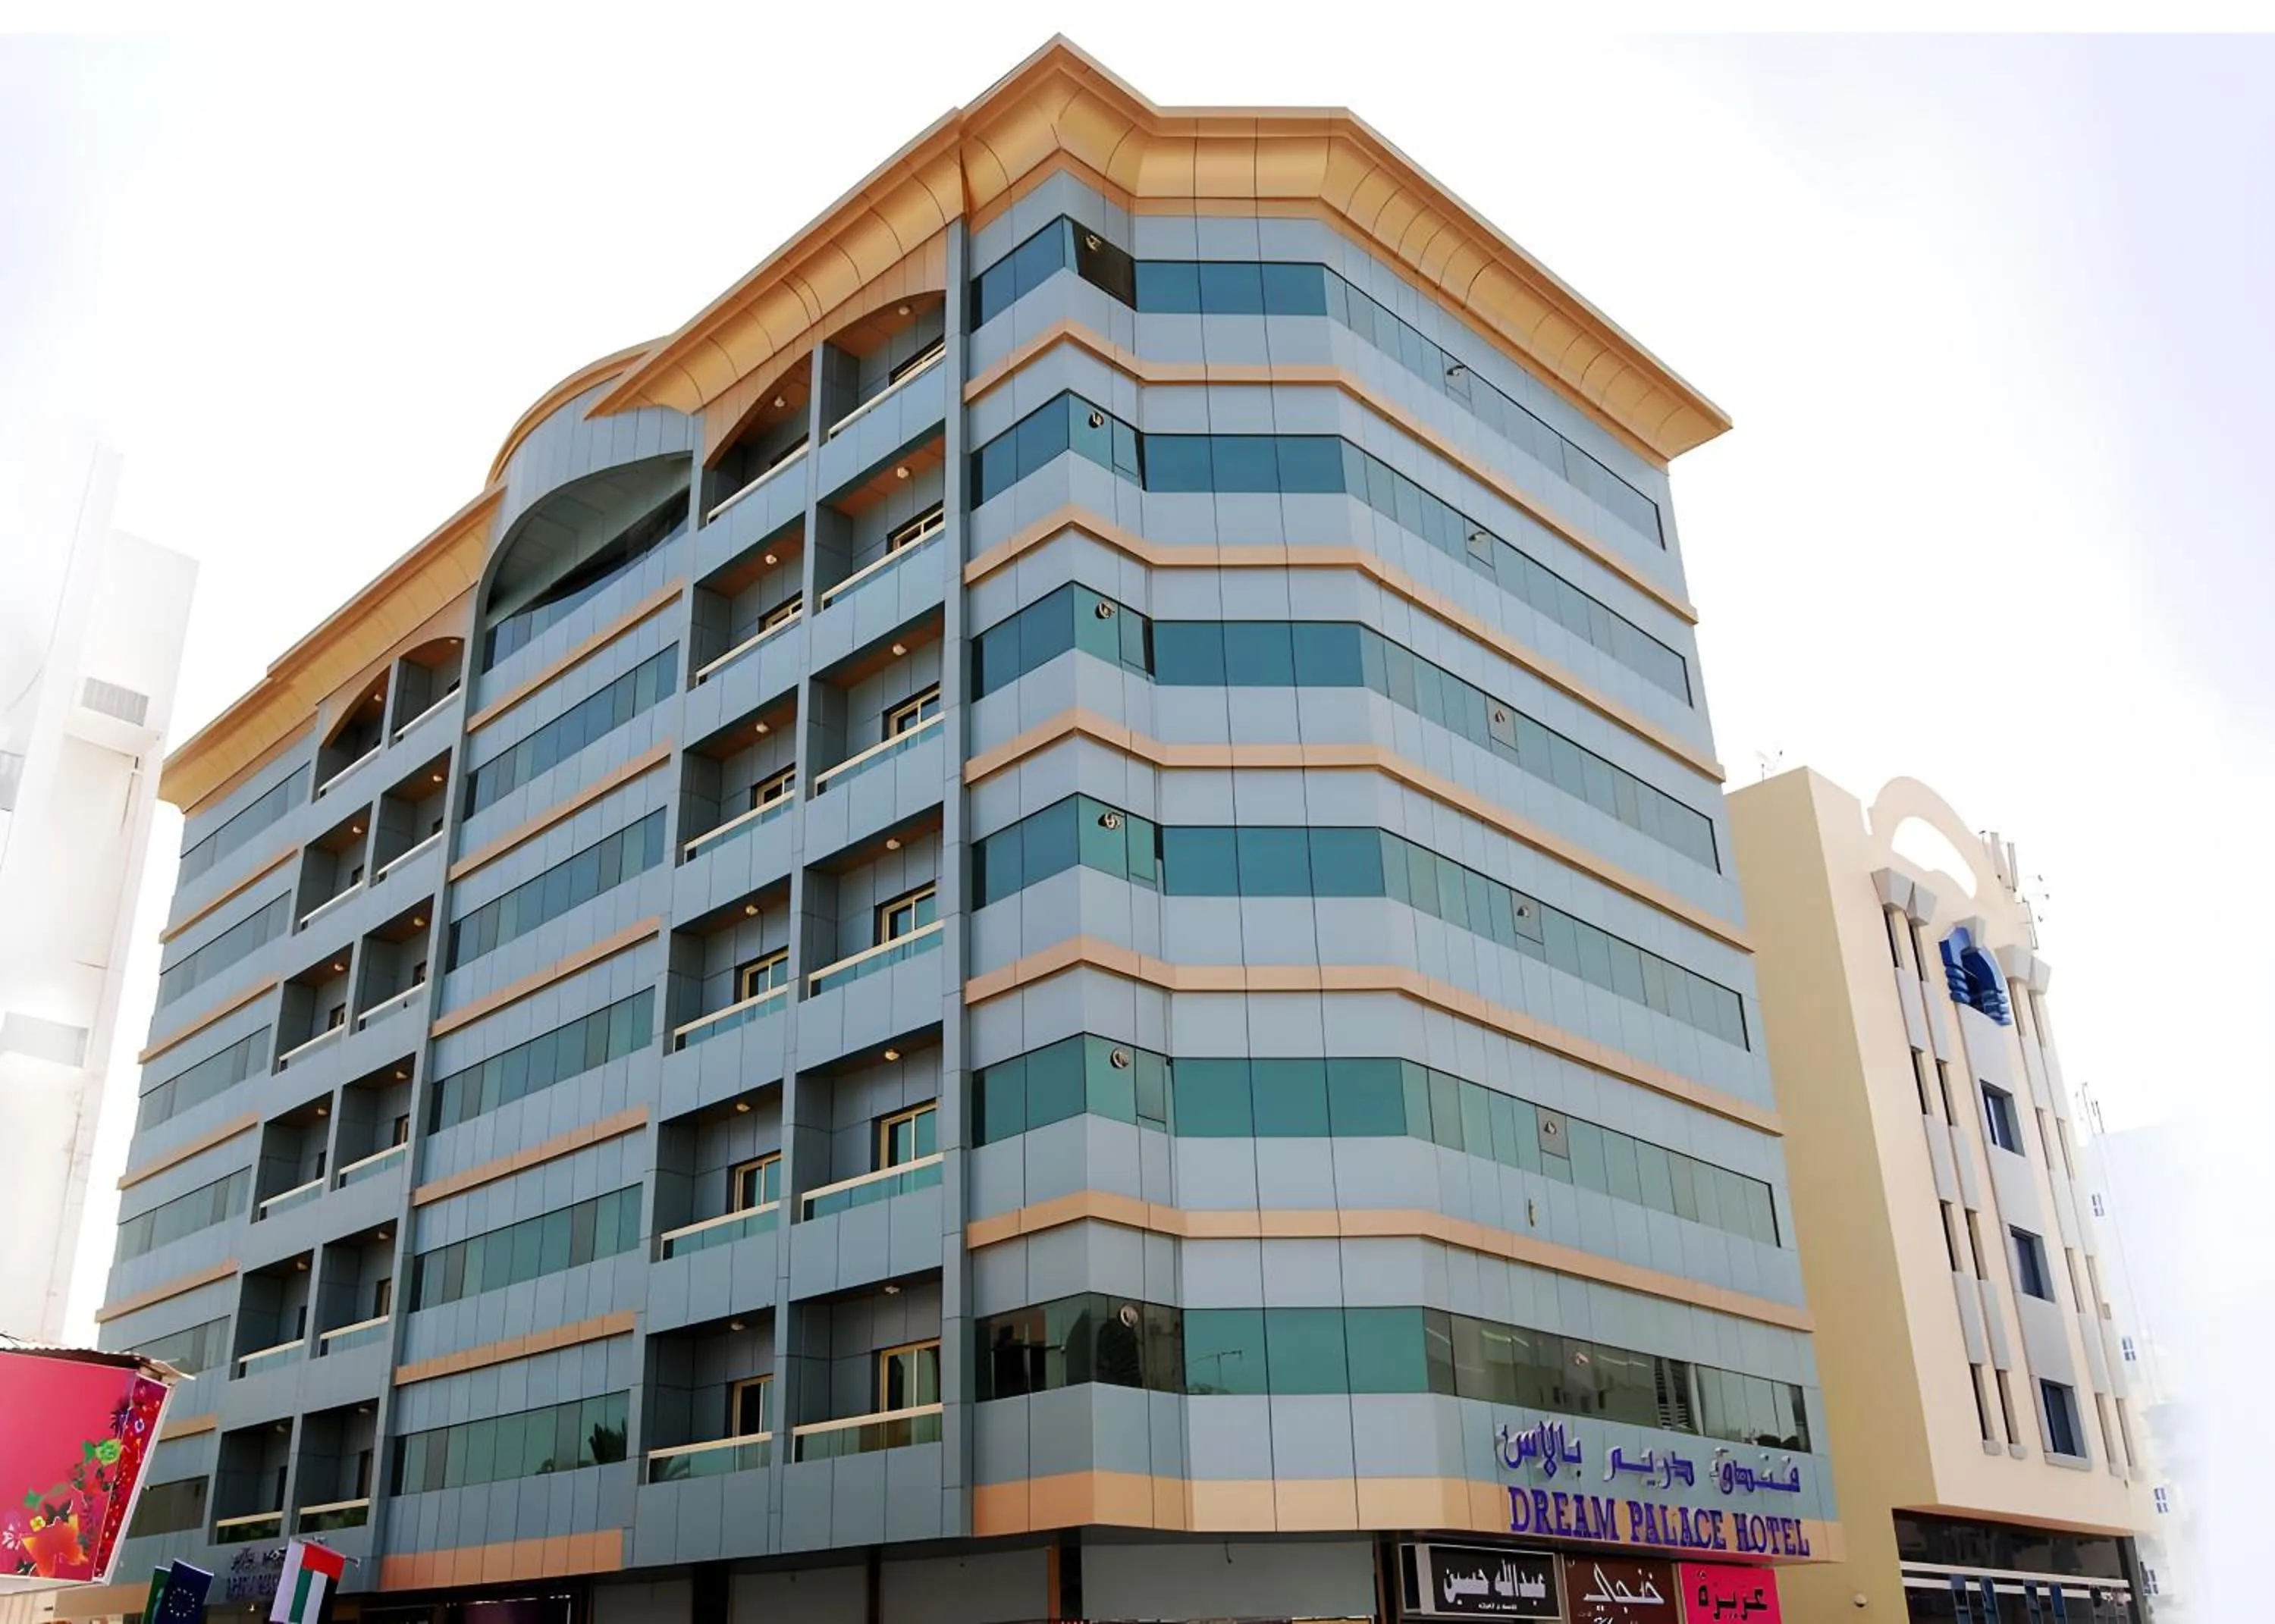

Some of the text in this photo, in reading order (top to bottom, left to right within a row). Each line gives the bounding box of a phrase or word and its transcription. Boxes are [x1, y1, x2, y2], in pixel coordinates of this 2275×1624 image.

[1495, 1420, 1801, 1495] فندق دريم بالاس
[1507, 1486, 1811, 1557] DREAM PALACE HOTEL
